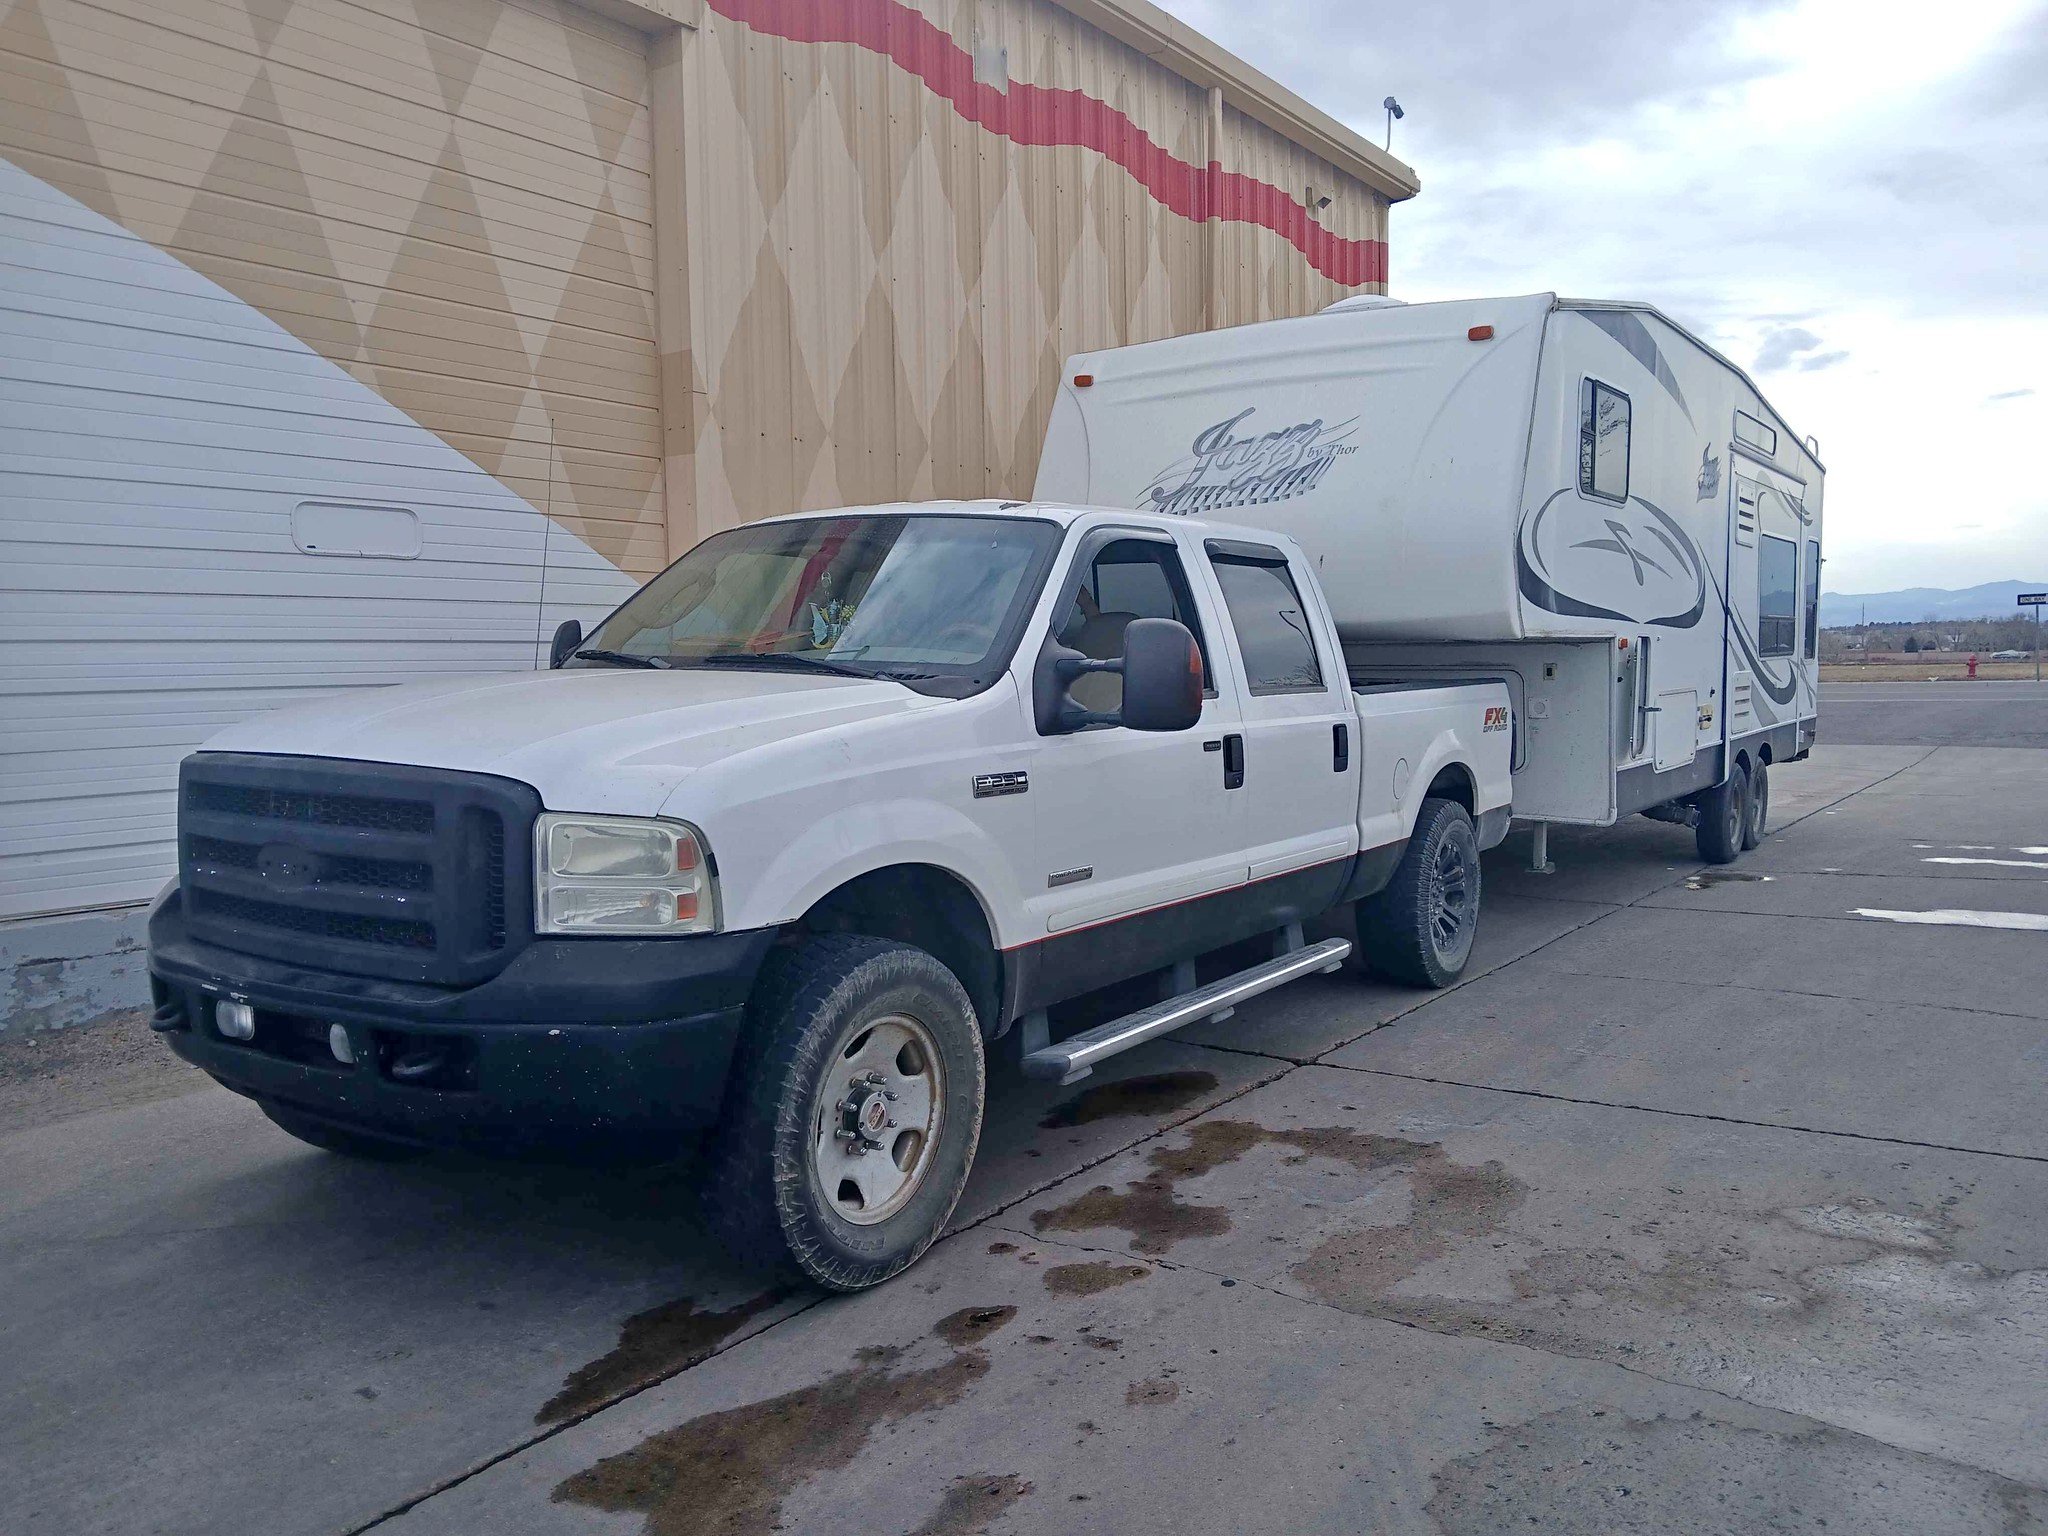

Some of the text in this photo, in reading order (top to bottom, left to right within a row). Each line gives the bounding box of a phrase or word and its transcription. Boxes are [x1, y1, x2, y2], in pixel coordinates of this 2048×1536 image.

[1307, 445, 1359, 460] by Thor
[1484, 707, 1508, 725] FX4
